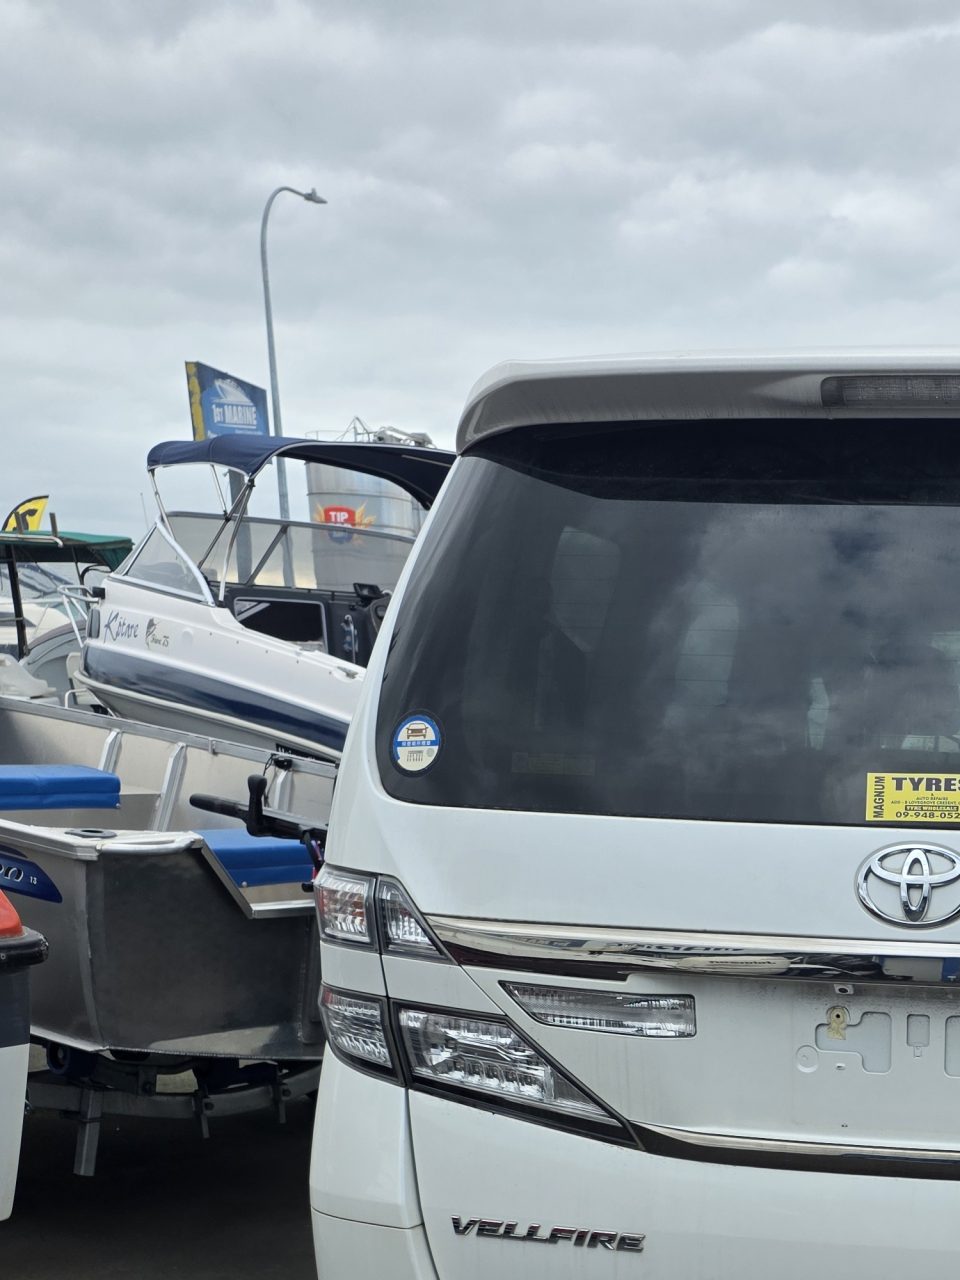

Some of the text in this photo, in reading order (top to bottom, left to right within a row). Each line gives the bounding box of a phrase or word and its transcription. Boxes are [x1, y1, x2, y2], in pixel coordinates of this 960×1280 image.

[224, 404, 257, 425] MARINE
[329, 511, 349, 522] TIP
[873, 776, 885, 818] MAGNUM
[451, 1214, 646, 1252] VELLFIRE
